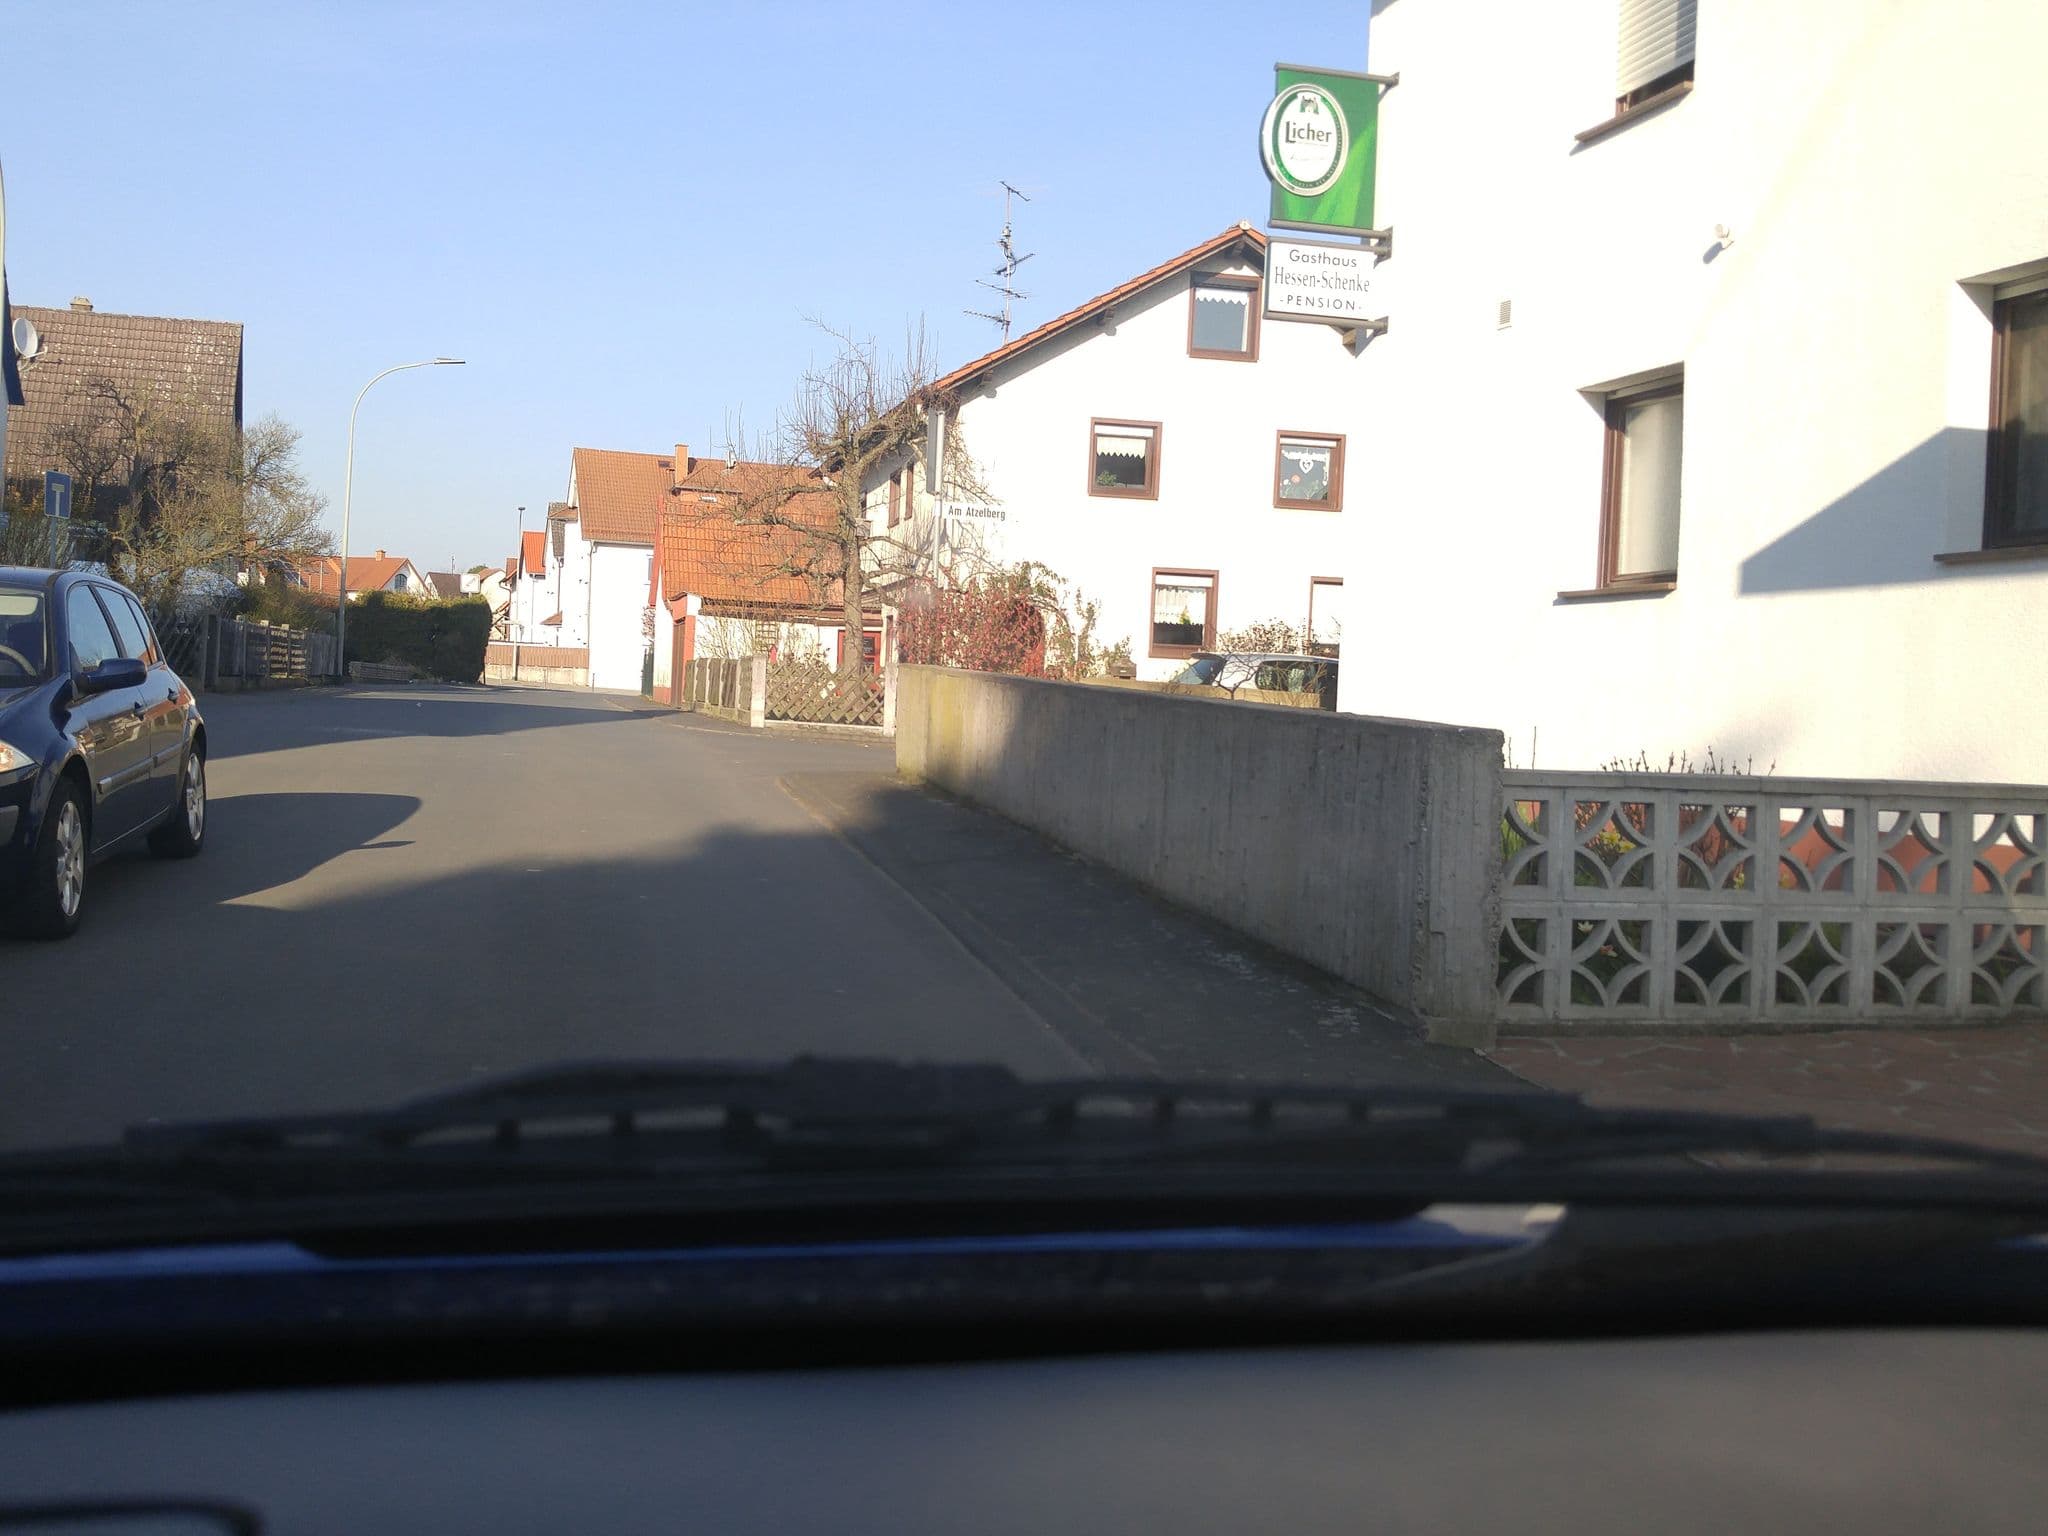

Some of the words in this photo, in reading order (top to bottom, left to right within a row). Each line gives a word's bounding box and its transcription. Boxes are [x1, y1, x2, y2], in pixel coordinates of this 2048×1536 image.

[1285, 121, 1331, 143] Licher
[1289, 249, 1357, 267] Gasthaus
[1275, 266, 1370, 292] Hessen-Schenke
[948, 505, 962, 516] Am
[966, 506, 1006, 521] Atzelberg
